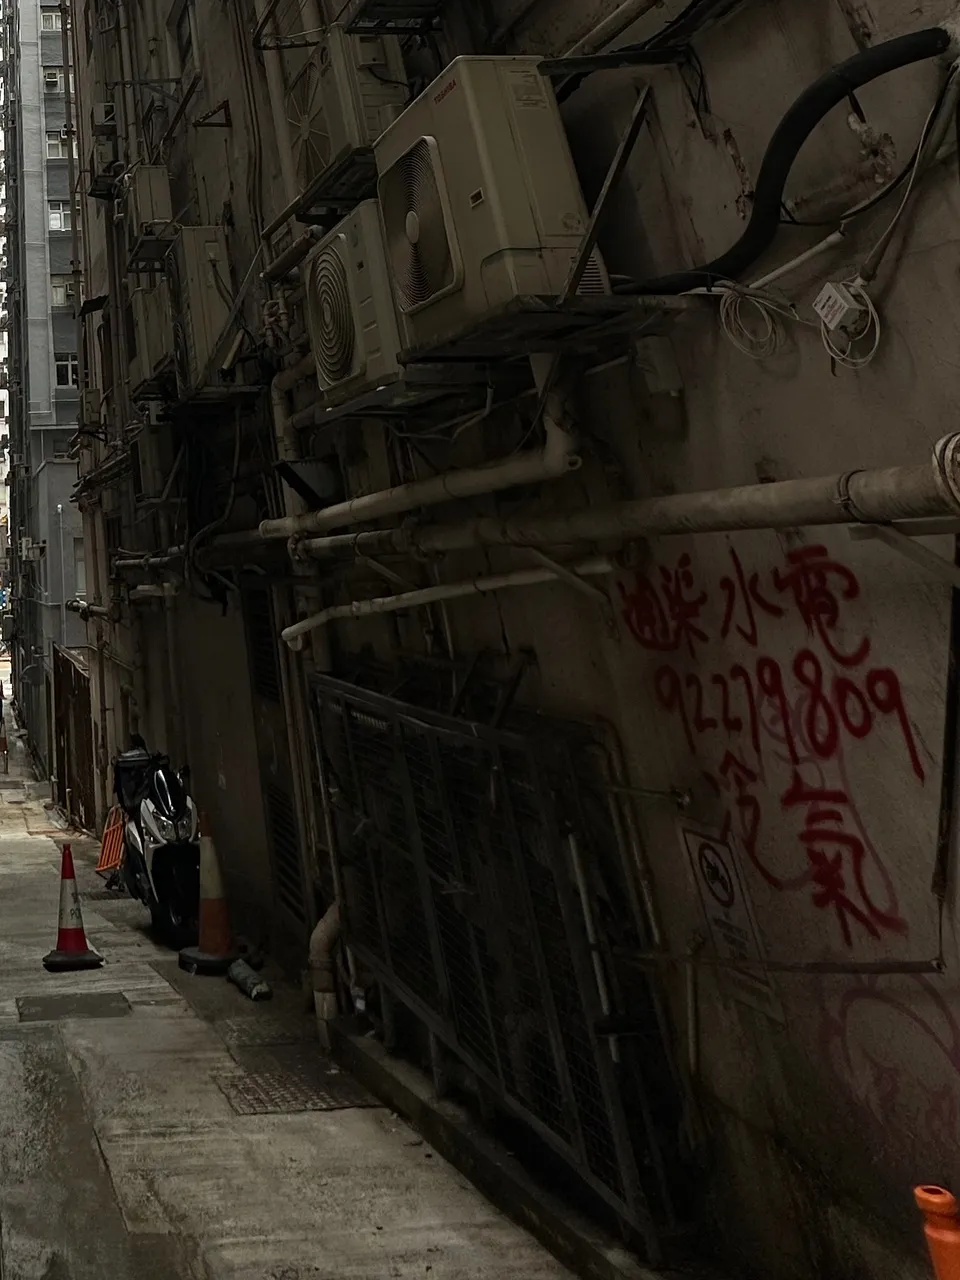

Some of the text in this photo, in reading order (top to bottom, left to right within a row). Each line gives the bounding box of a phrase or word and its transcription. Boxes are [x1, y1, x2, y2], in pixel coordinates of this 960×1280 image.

[433, 79, 457, 105] TOSHIBA
[655, 647, 926, 786] 92279809
[702, 749, 910, 946] 冷氣
